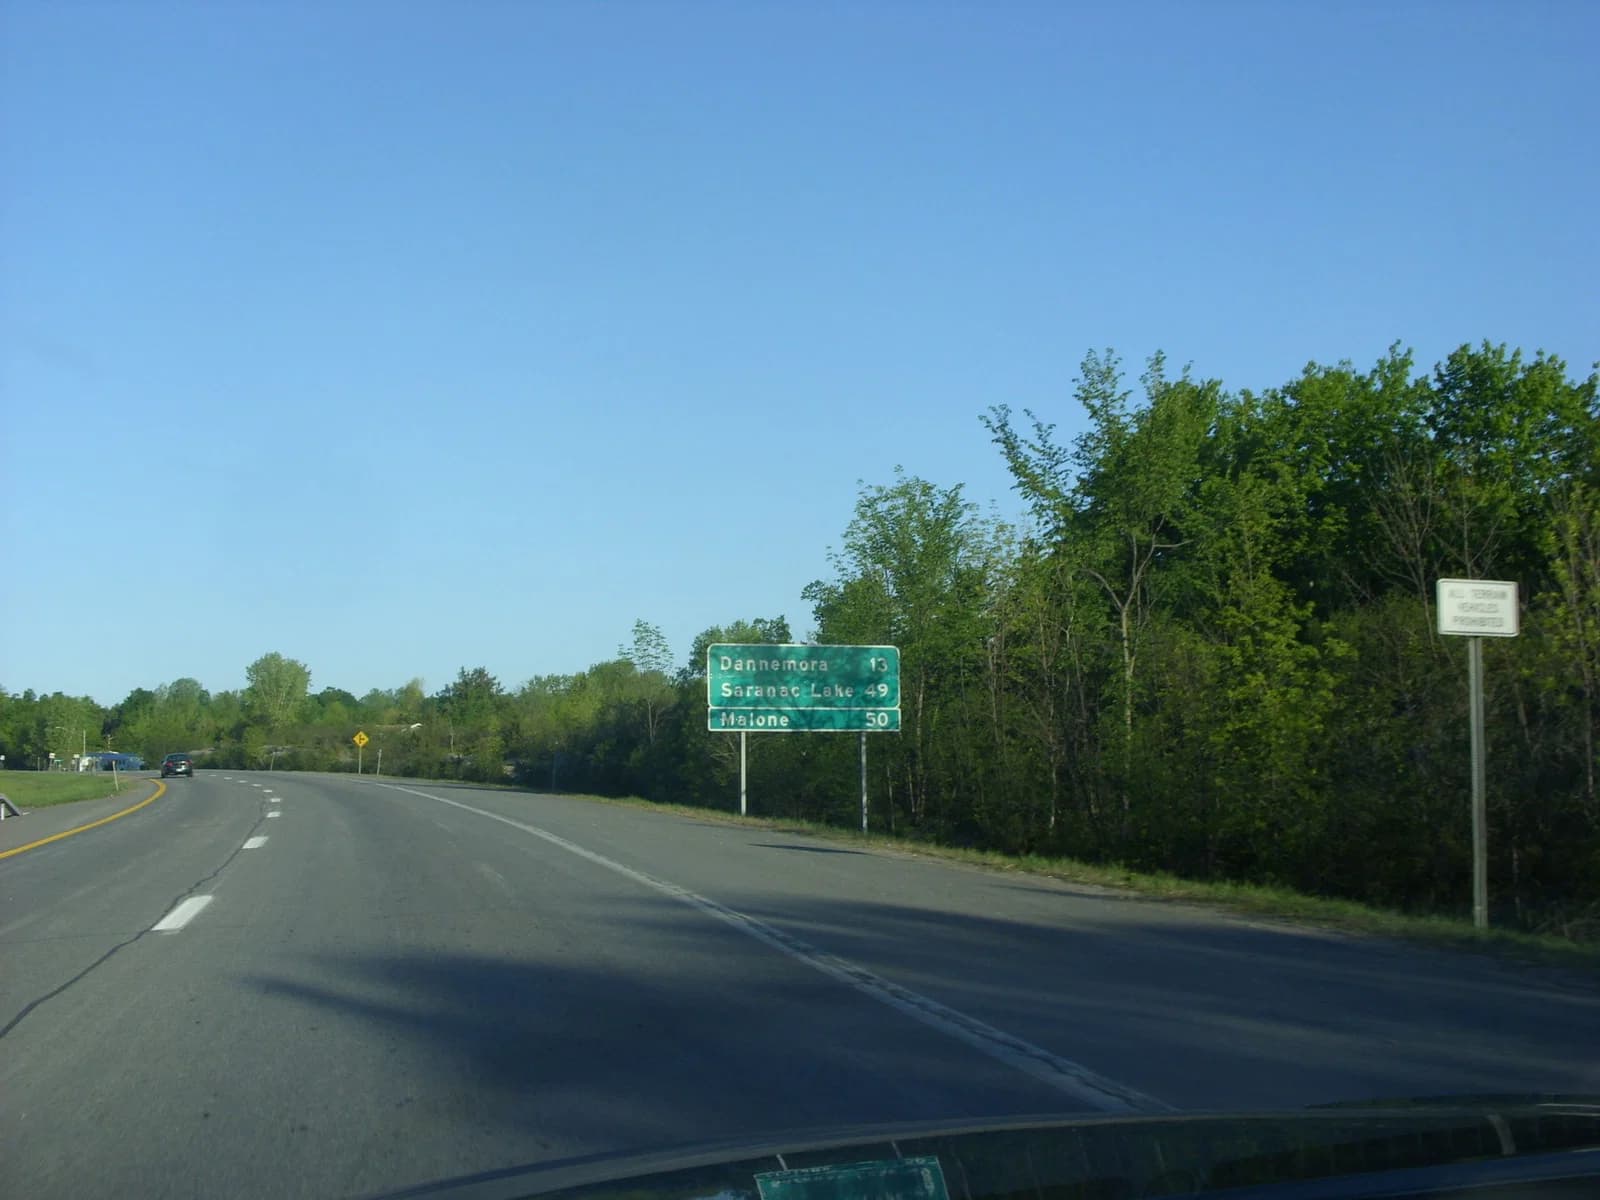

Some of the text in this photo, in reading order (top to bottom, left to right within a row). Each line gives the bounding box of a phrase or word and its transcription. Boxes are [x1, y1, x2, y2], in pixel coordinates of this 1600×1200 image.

[720, 656, 888, 673] Dannemora 13
[721, 684, 889, 698] Saranac Lake 49
[721, 711, 889, 727] Malone 50
